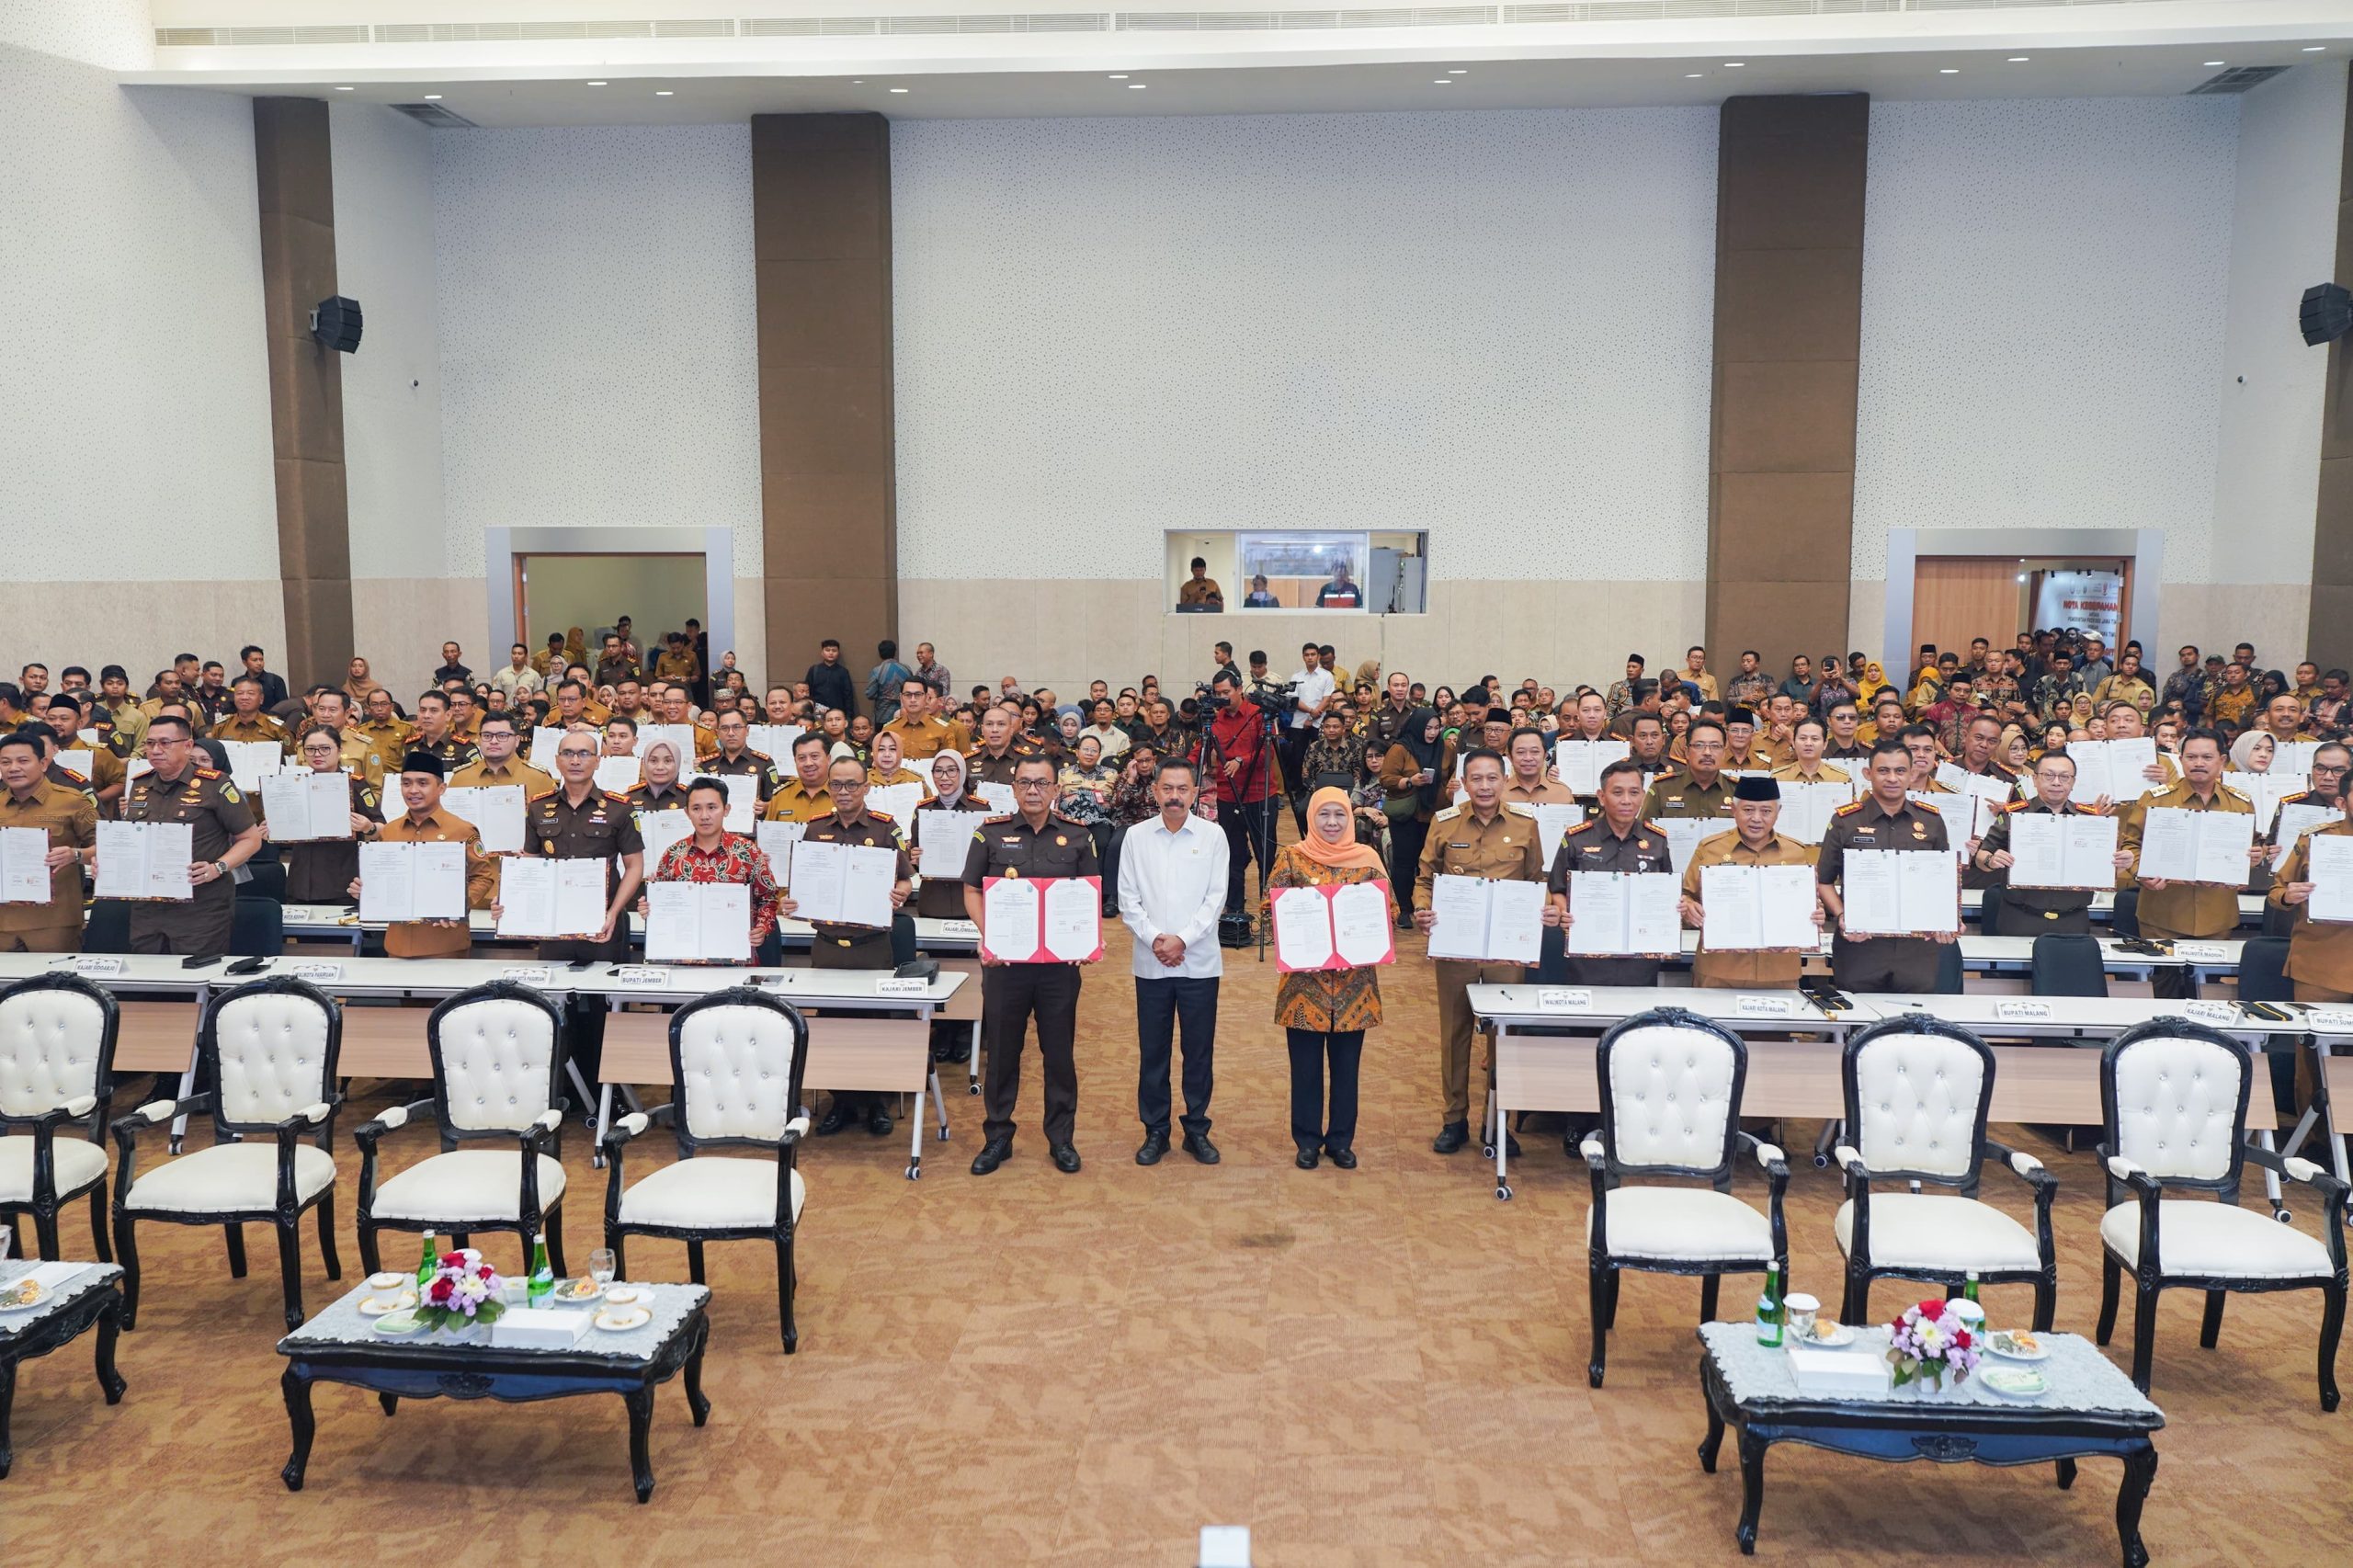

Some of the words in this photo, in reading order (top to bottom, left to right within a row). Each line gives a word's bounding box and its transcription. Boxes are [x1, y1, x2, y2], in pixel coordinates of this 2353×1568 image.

[2063, 600, 2079, 609] NOTA
[2187, 1007, 2206, 1017] KAJARI
[2206, 1012, 2231, 1022] MALANG
[2316, 1017, 2339, 1026] BUPATI
